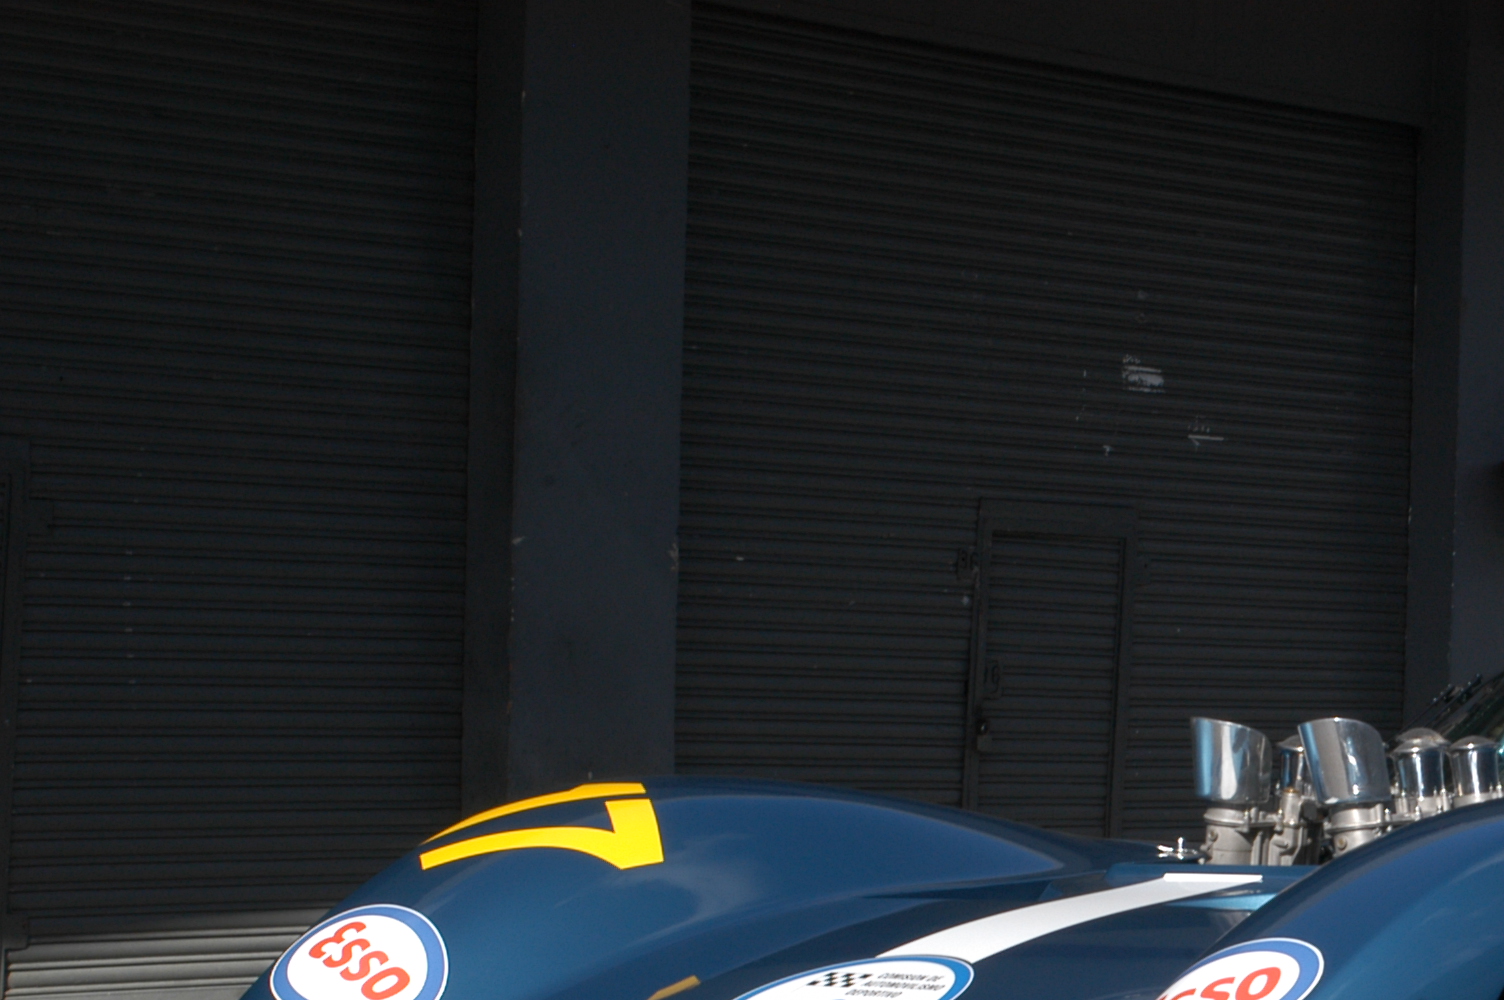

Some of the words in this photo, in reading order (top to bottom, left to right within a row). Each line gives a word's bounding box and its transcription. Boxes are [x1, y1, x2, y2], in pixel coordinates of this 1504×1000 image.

[419, 782, 665, 870] 17
[308, 920, 411, 1000] ESSO
[927, 974, 945, 983] DE
[861, 980, 946, 992] AUTOMOVILISMO
[845, 989, 903, 999] DEPORTIVO
